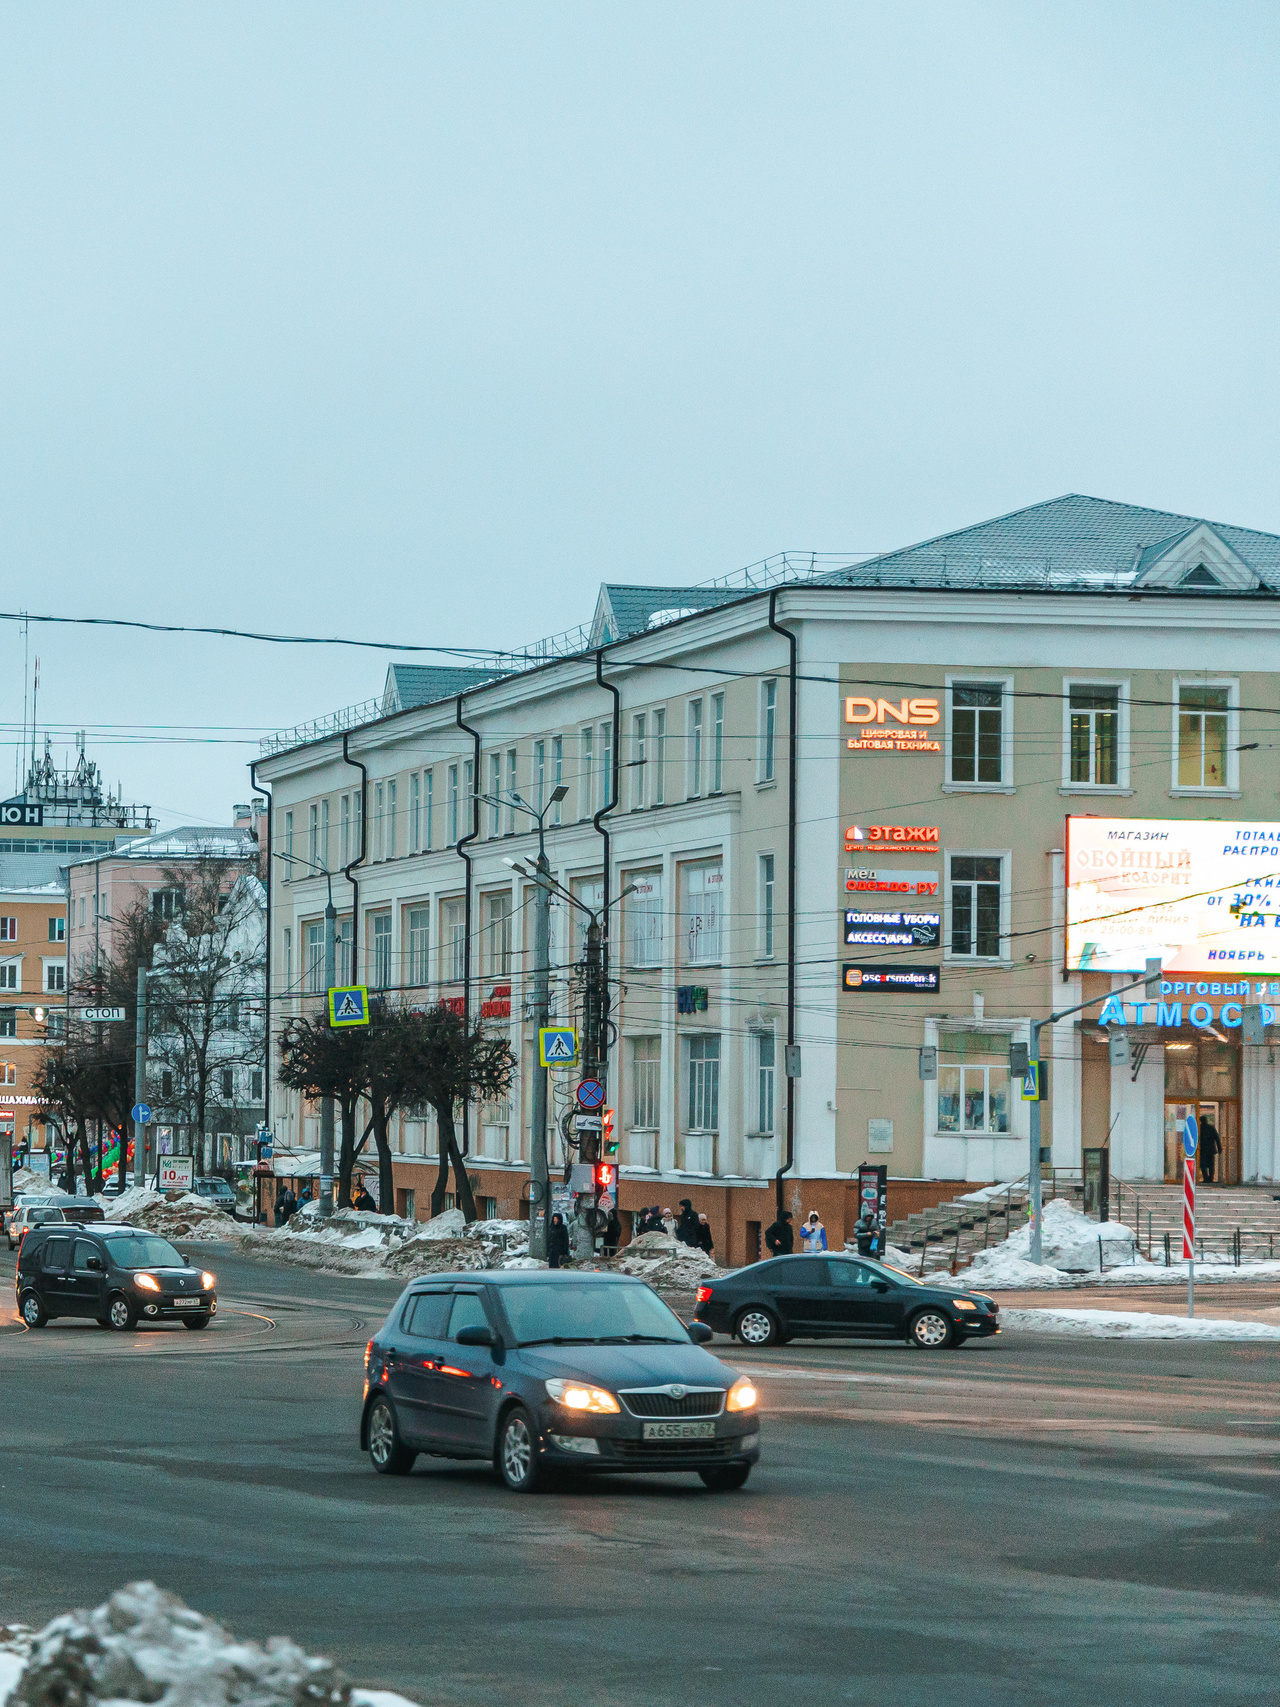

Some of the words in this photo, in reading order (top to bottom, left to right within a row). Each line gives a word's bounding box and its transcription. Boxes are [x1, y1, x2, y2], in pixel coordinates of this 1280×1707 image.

[845, 697, 940, 725] DNS
[861, 729, 917, 739] ЦИФРОВАЯ
[919, 730, 928, 739] И
[847, 739, 894, 749] БЫТОВАЯ
[895, 740, 941, 751] ТЕХНИКА
[1107, 831, 1169, 841] МАГАЗИН
[1235, 831, 1280, 842] ТОТАЛ
[1076, 848, 1192, 869] ОБОЙНЫЙ
[1207, 896, 1223, 906] ОТ
[846, 912, 901, 924] ГОЛОВНЫЕ
[903, 914, 940, 925] УБОРЫ
[1239, 914, 1266, 927] НА
[847, 933, 913, 944] АКСЕССУАРЫ
[1207, 949, 1265, 960] НОЯБРЬ
[1160, 980, 1251, 996] ОРГОВЫЙ
[84, 1007, 121, 1019] СТОП
[163, 1170, 177, 1181] 10
